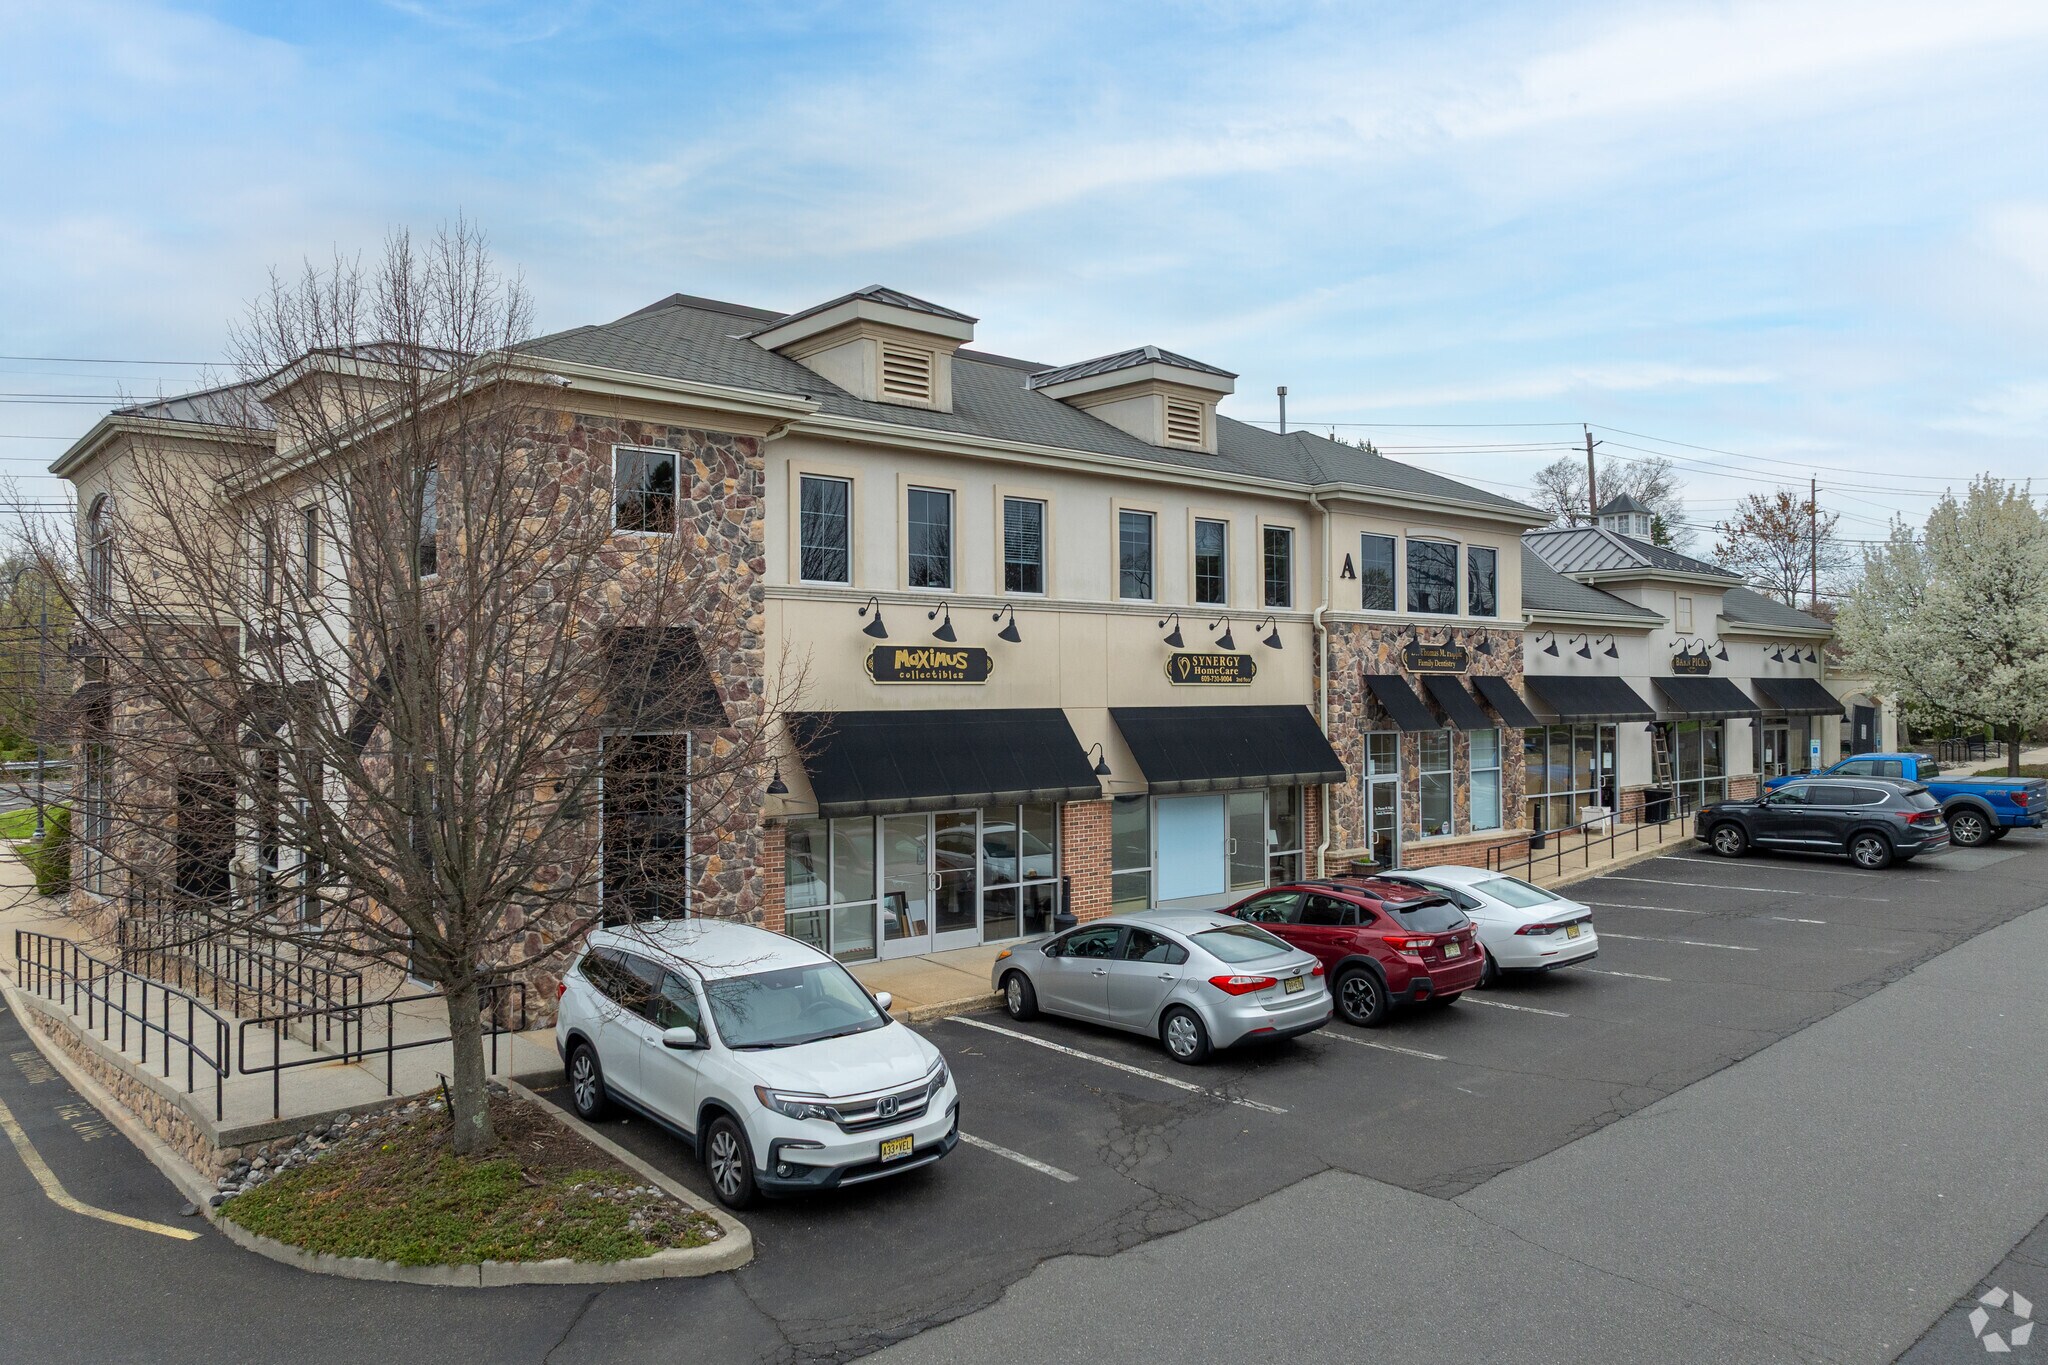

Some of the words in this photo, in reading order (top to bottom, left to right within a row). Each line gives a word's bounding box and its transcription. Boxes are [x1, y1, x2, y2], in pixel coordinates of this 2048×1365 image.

[1340, 553, 1357, 579] A
[1192, 656, 1240, 667] SYNERGY
[1434, 660, 1455, 668] Dentistry
[899, 671, 964, 679] collectibles
[1194, 667, 1239, 675] HomeCare
